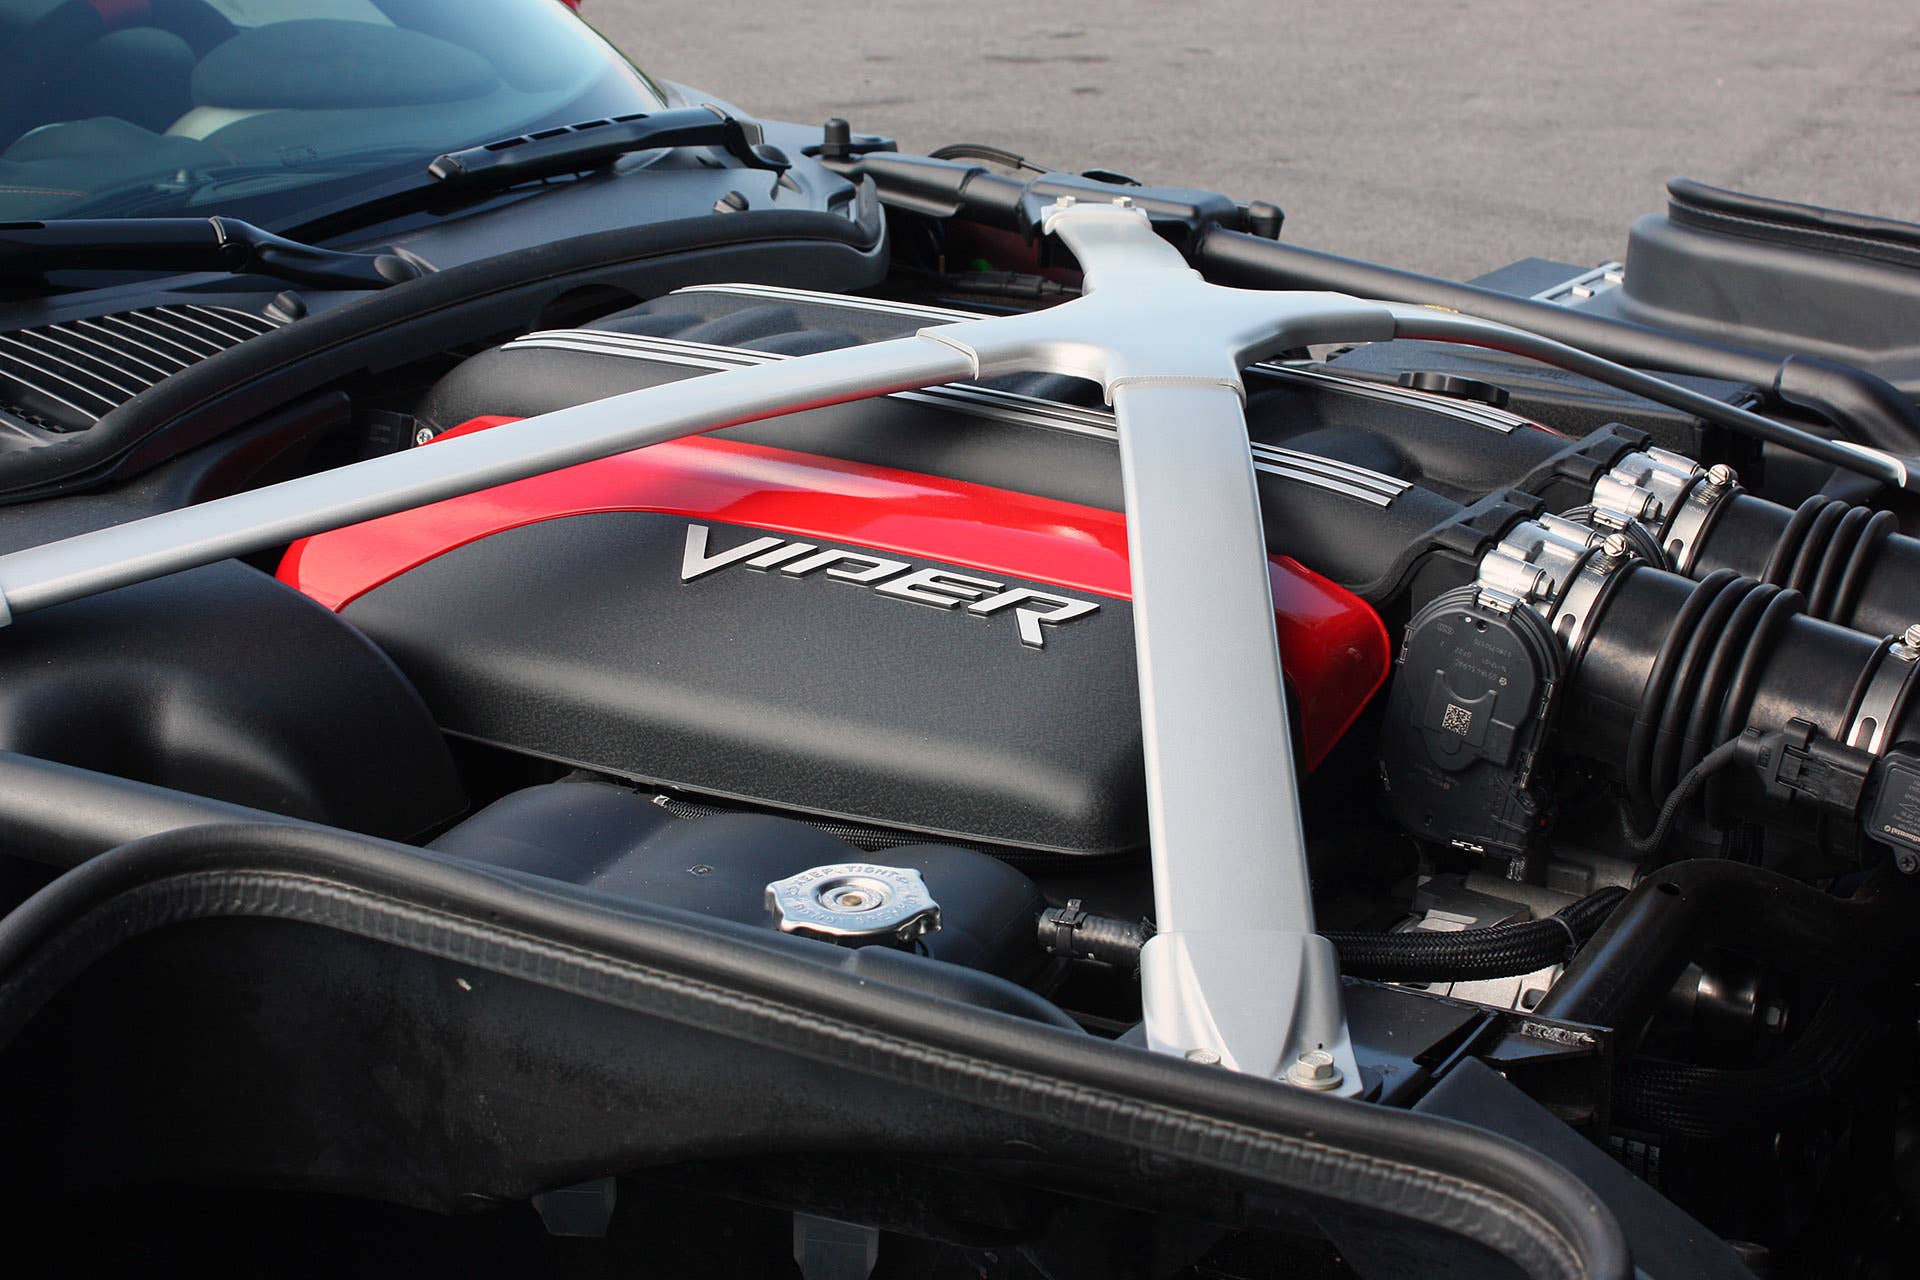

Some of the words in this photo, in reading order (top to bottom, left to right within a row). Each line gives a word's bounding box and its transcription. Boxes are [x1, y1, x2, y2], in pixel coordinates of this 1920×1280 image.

[681, 524, 1100, 648] VIPER
[797, 868, 834, 887] KEEP
[847, 866, 899, 879] TIGHT
